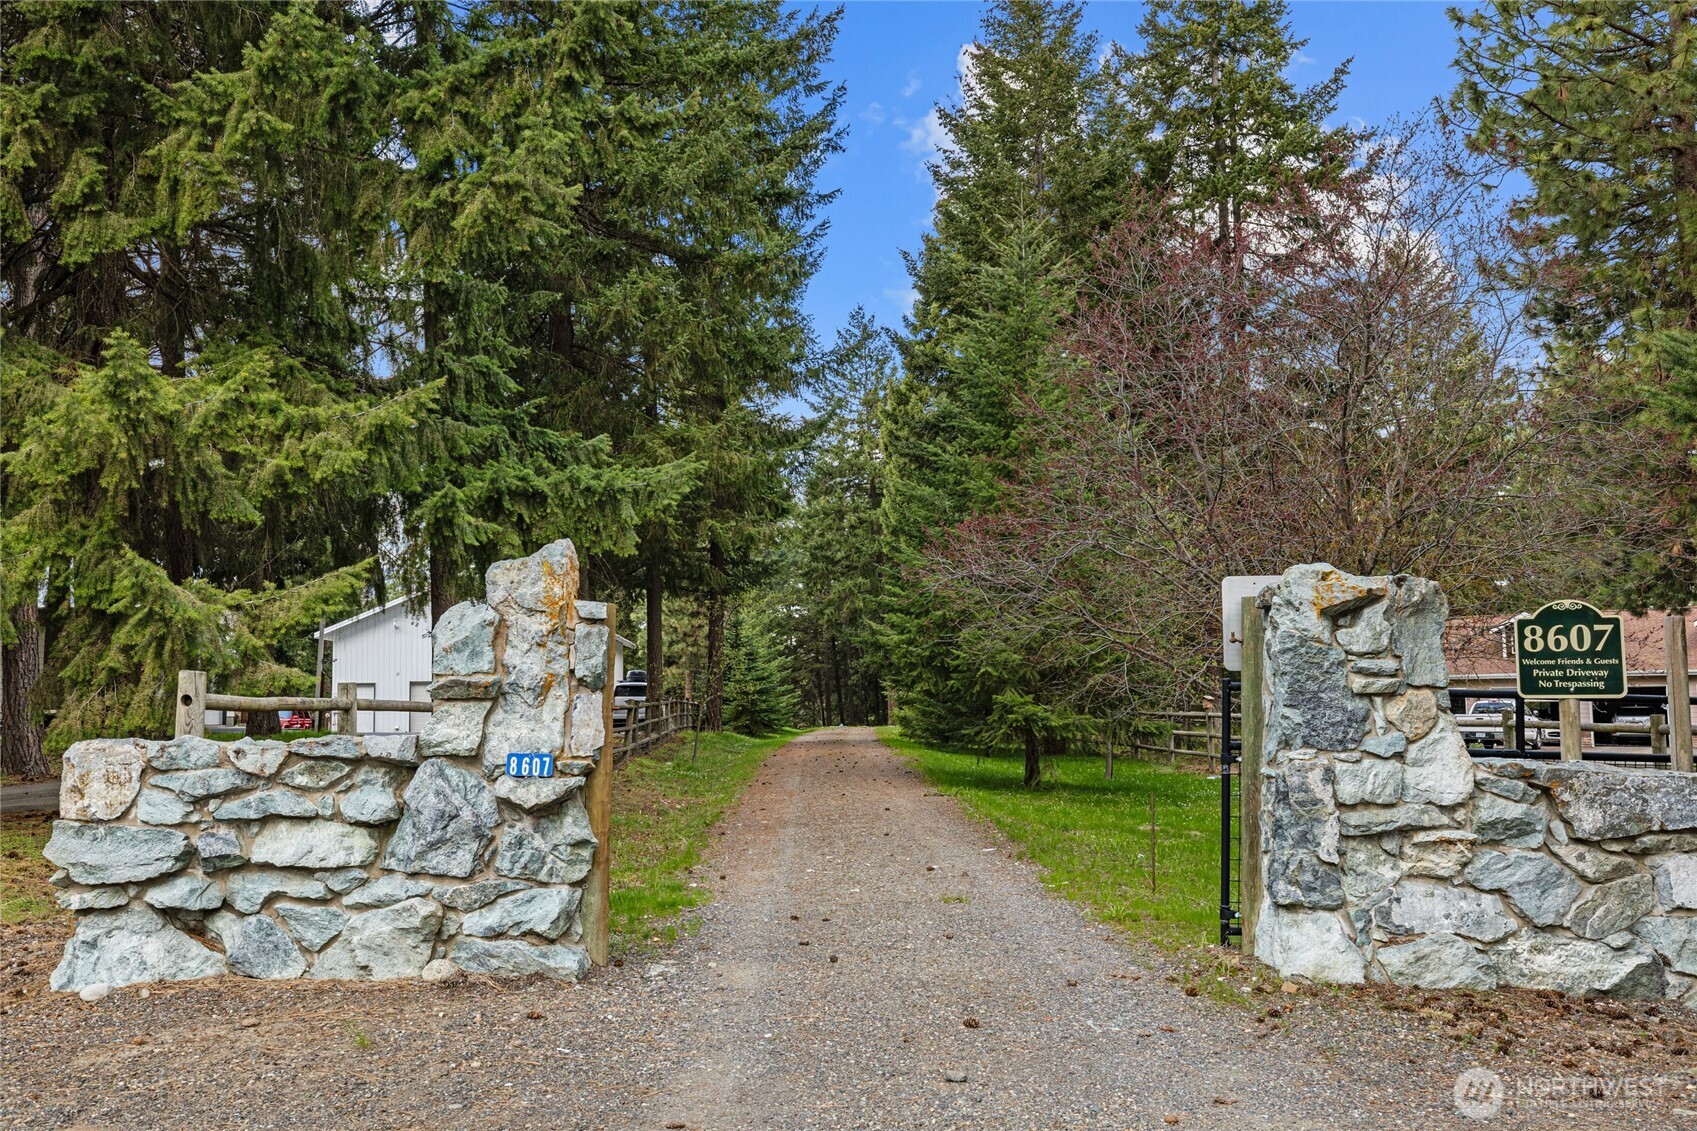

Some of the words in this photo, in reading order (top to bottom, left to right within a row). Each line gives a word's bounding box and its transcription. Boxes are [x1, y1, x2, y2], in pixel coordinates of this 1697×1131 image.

[1523, 624, 1614, 652] 8607
[1522, 657, 1555, 665] Welcome
[1557, 657, 1584, 665] Friends
[1594, 657, 1619, 665] Guests
[1533, 668, 1564, 677] Private
[1566, 667, 1609, 678] Driveway
[1538, 680, 1552, 688] No
[1555, 679, 1605, 689] Trespassing
[509, 756, 550, 777] 8607
